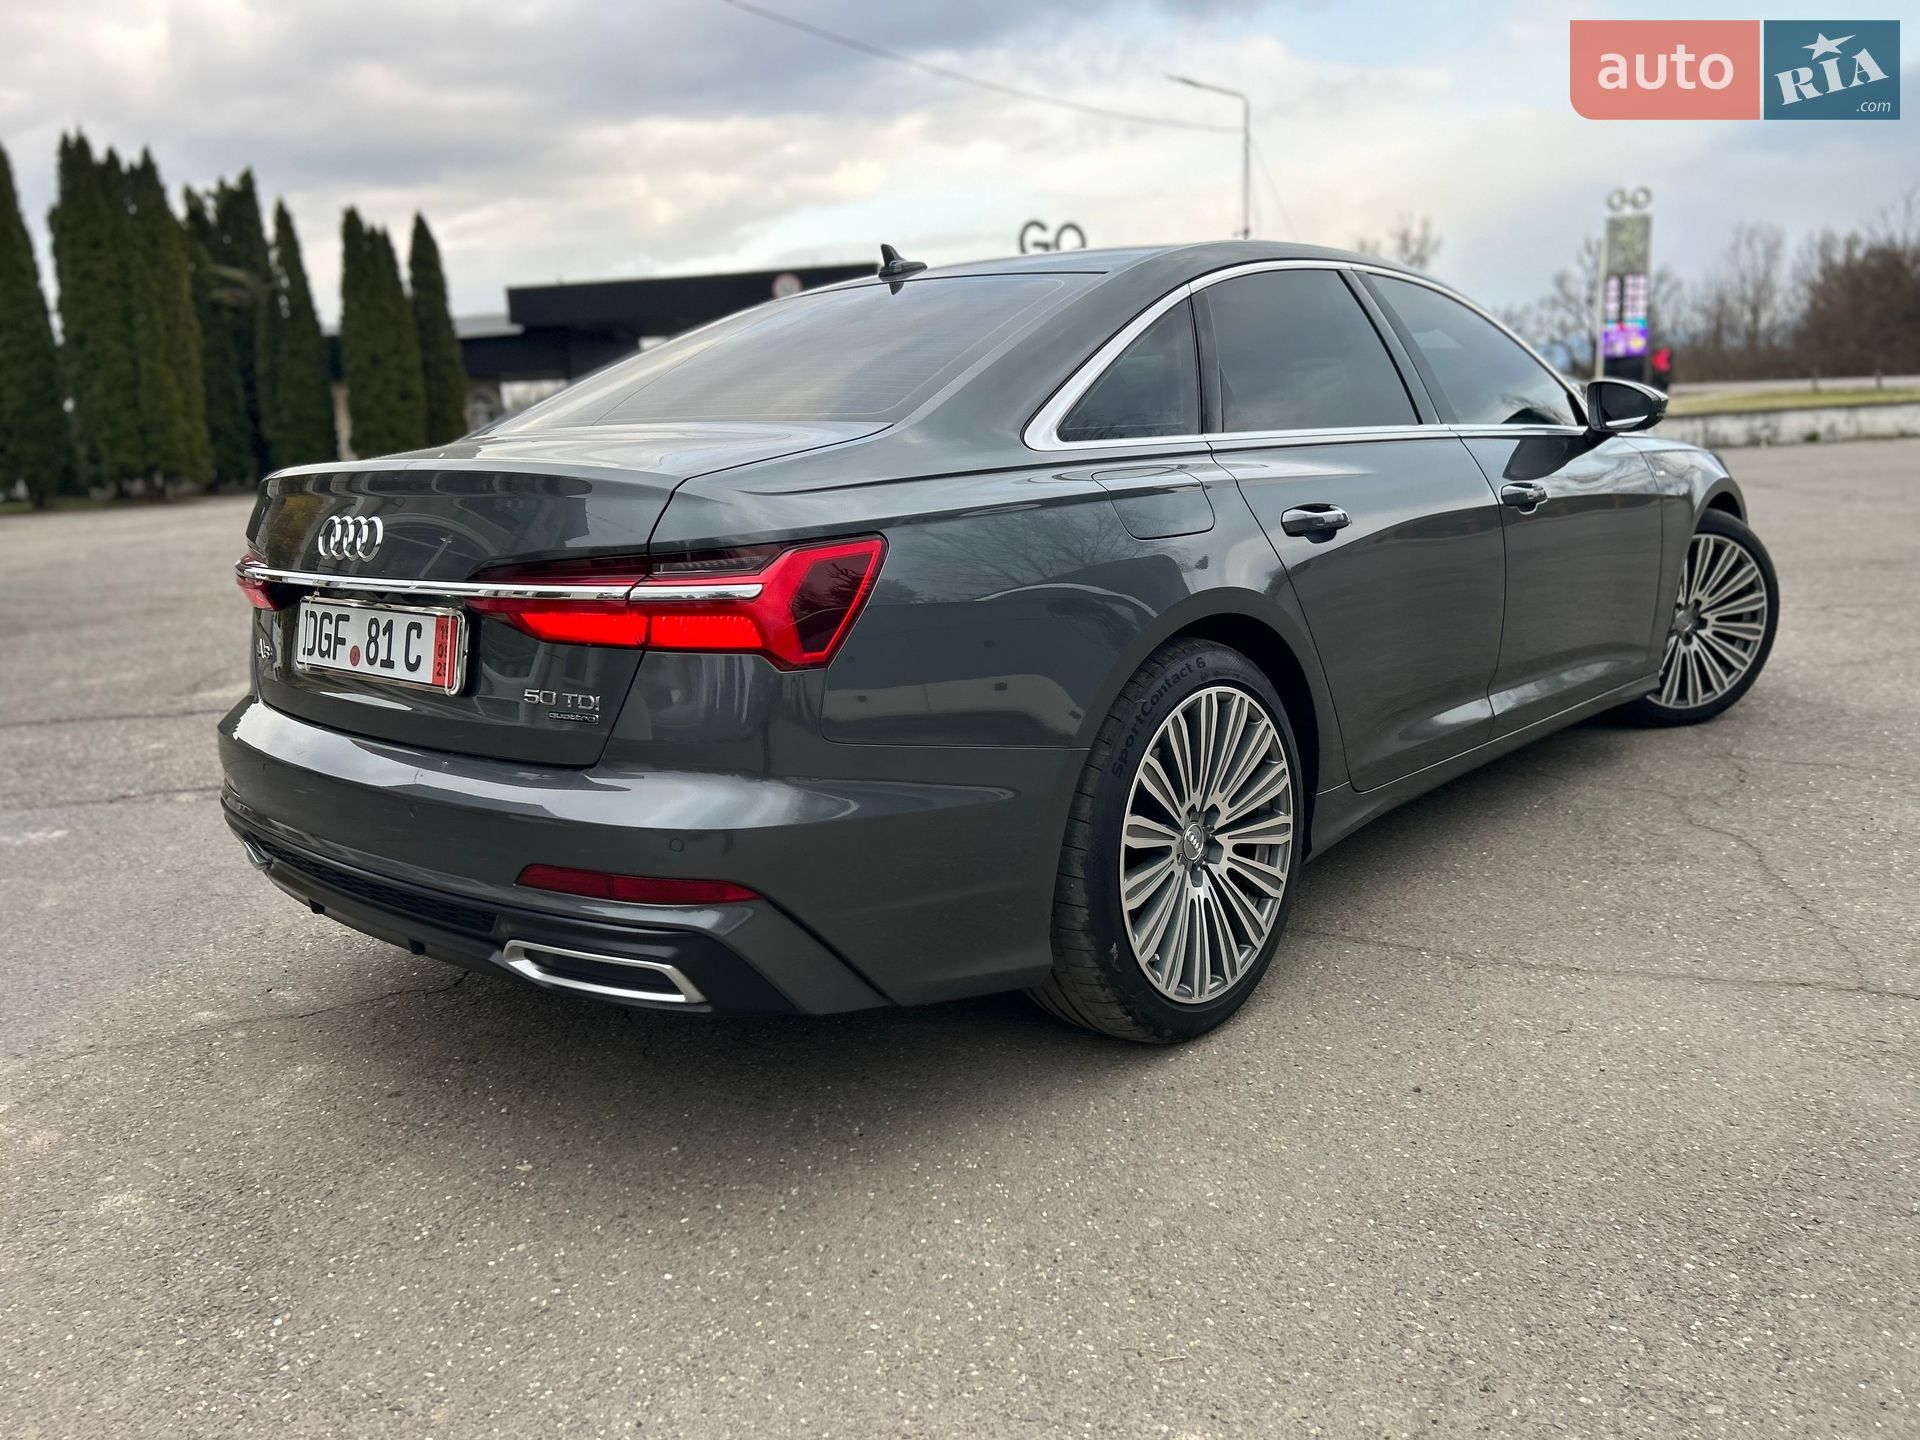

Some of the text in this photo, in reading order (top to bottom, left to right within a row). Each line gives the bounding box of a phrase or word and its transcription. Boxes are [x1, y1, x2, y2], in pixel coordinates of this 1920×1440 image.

[1019, 220, 1087, 254] GO
[303, 609, 423, 673] DGF 81 C
[524, 688, 600, 711] 50 TDI
[548, 712, 596, 723] quattro
[1111, 656, 1206, 778] SportContact 6
